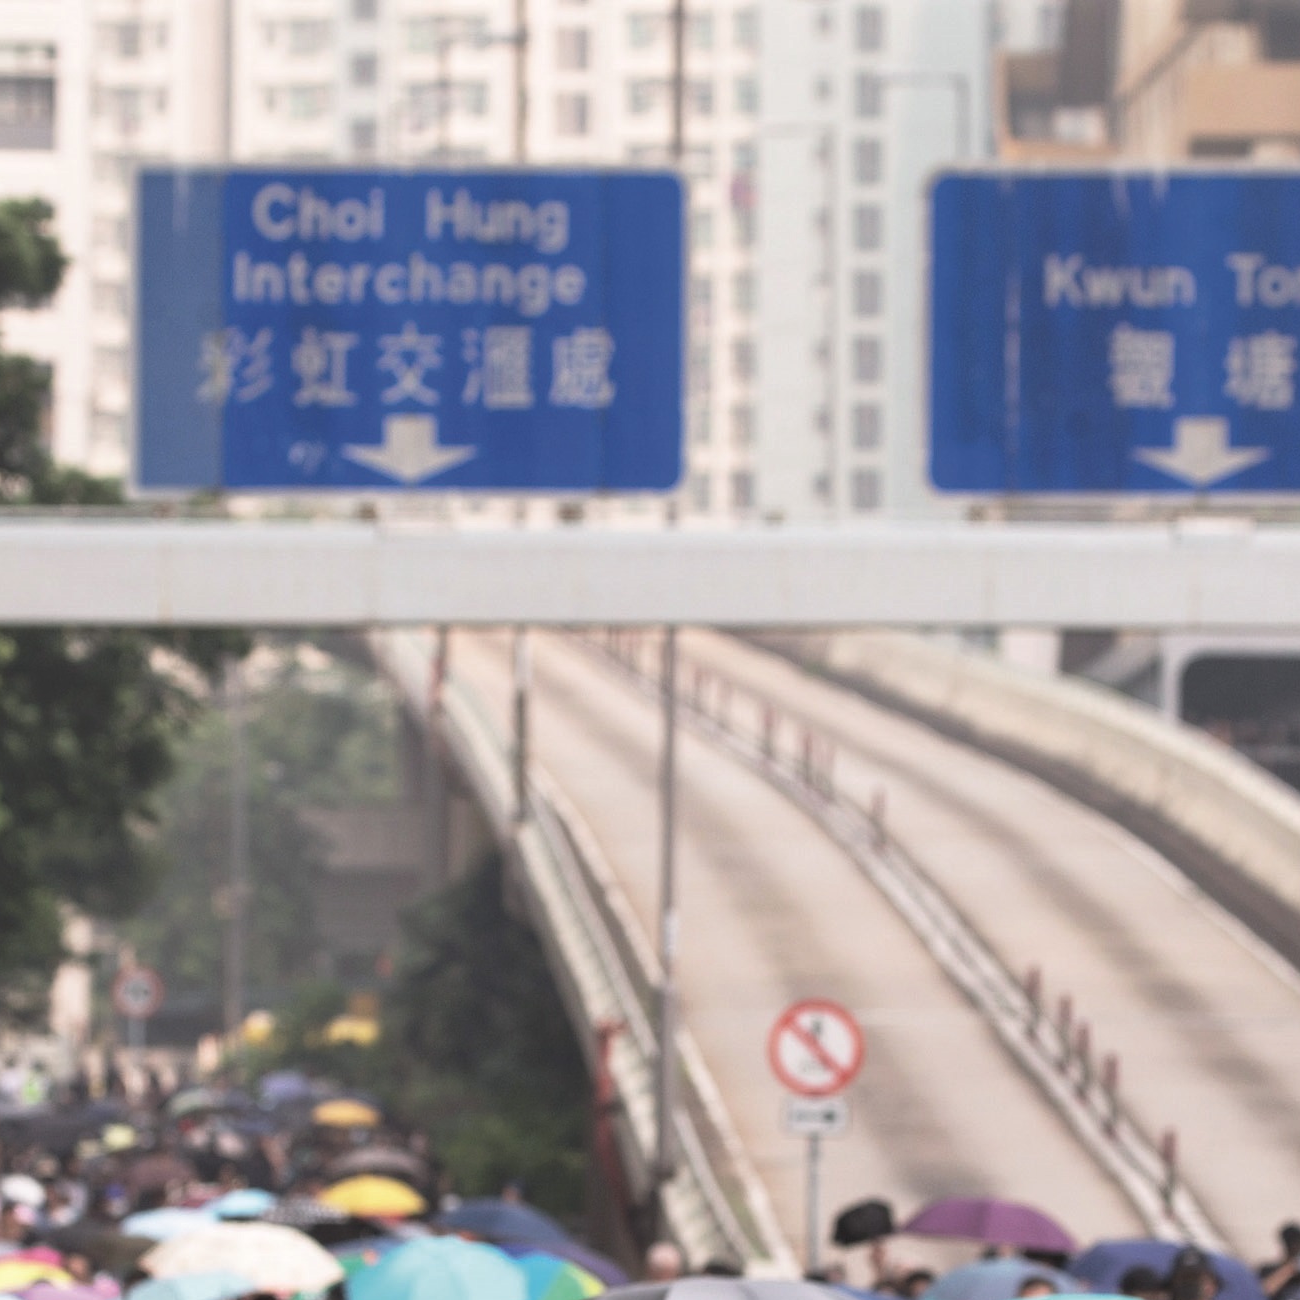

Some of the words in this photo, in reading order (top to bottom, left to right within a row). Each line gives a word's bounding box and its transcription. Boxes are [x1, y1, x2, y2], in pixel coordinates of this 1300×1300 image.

[251, 183, 386, 242] Choi
[424, 186, 570, 254] Hung
[232, 251, 587, 317] Interchange
[1044, 252, 1196, 309] Kwun
